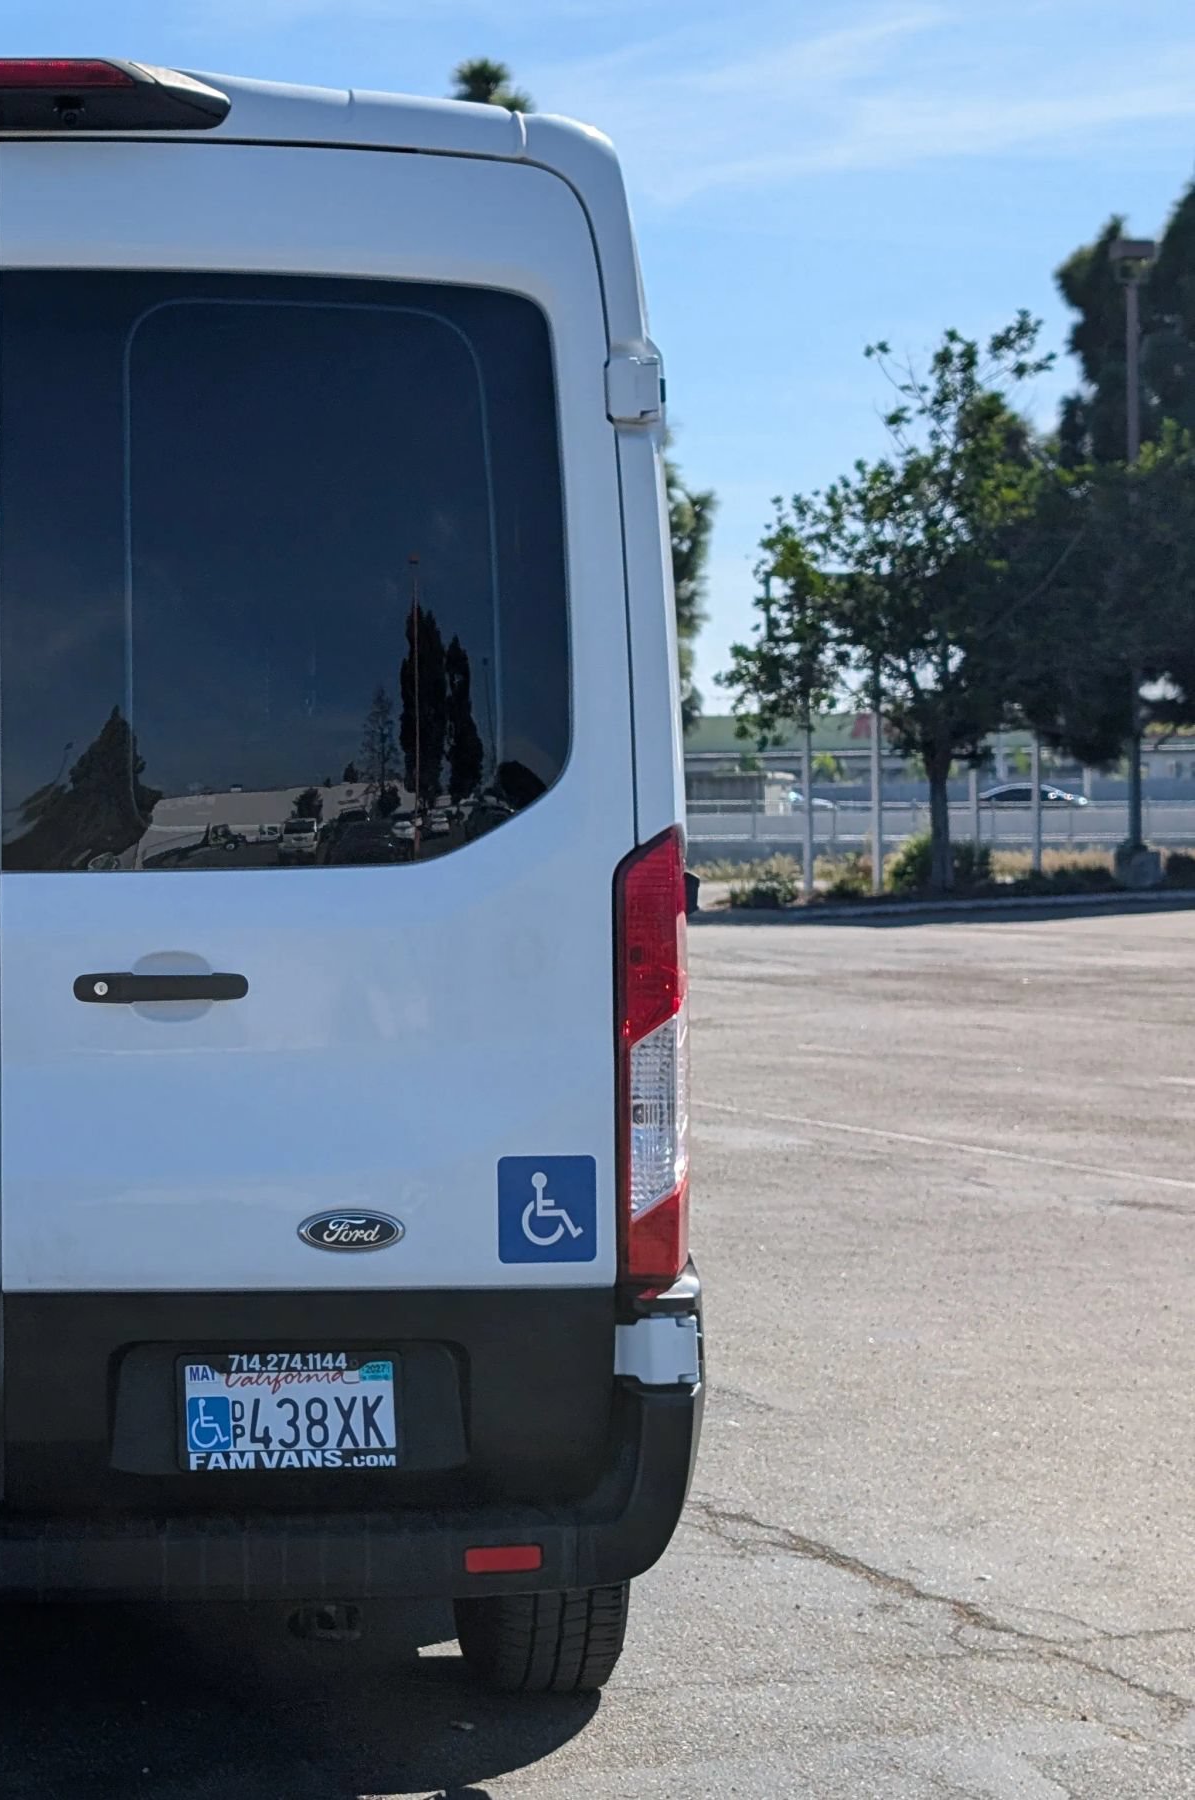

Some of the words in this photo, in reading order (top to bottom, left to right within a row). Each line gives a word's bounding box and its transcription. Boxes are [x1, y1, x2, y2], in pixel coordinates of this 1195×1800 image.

[323, 1218, 380, 1242] Ford
[189, 1366, 215, 1381] MAY
[228, 1353, 347, 1372] 714.274.1144
[225, 1370, 346, 1395] California
[250, 1395, 387, 1450] 438XK
